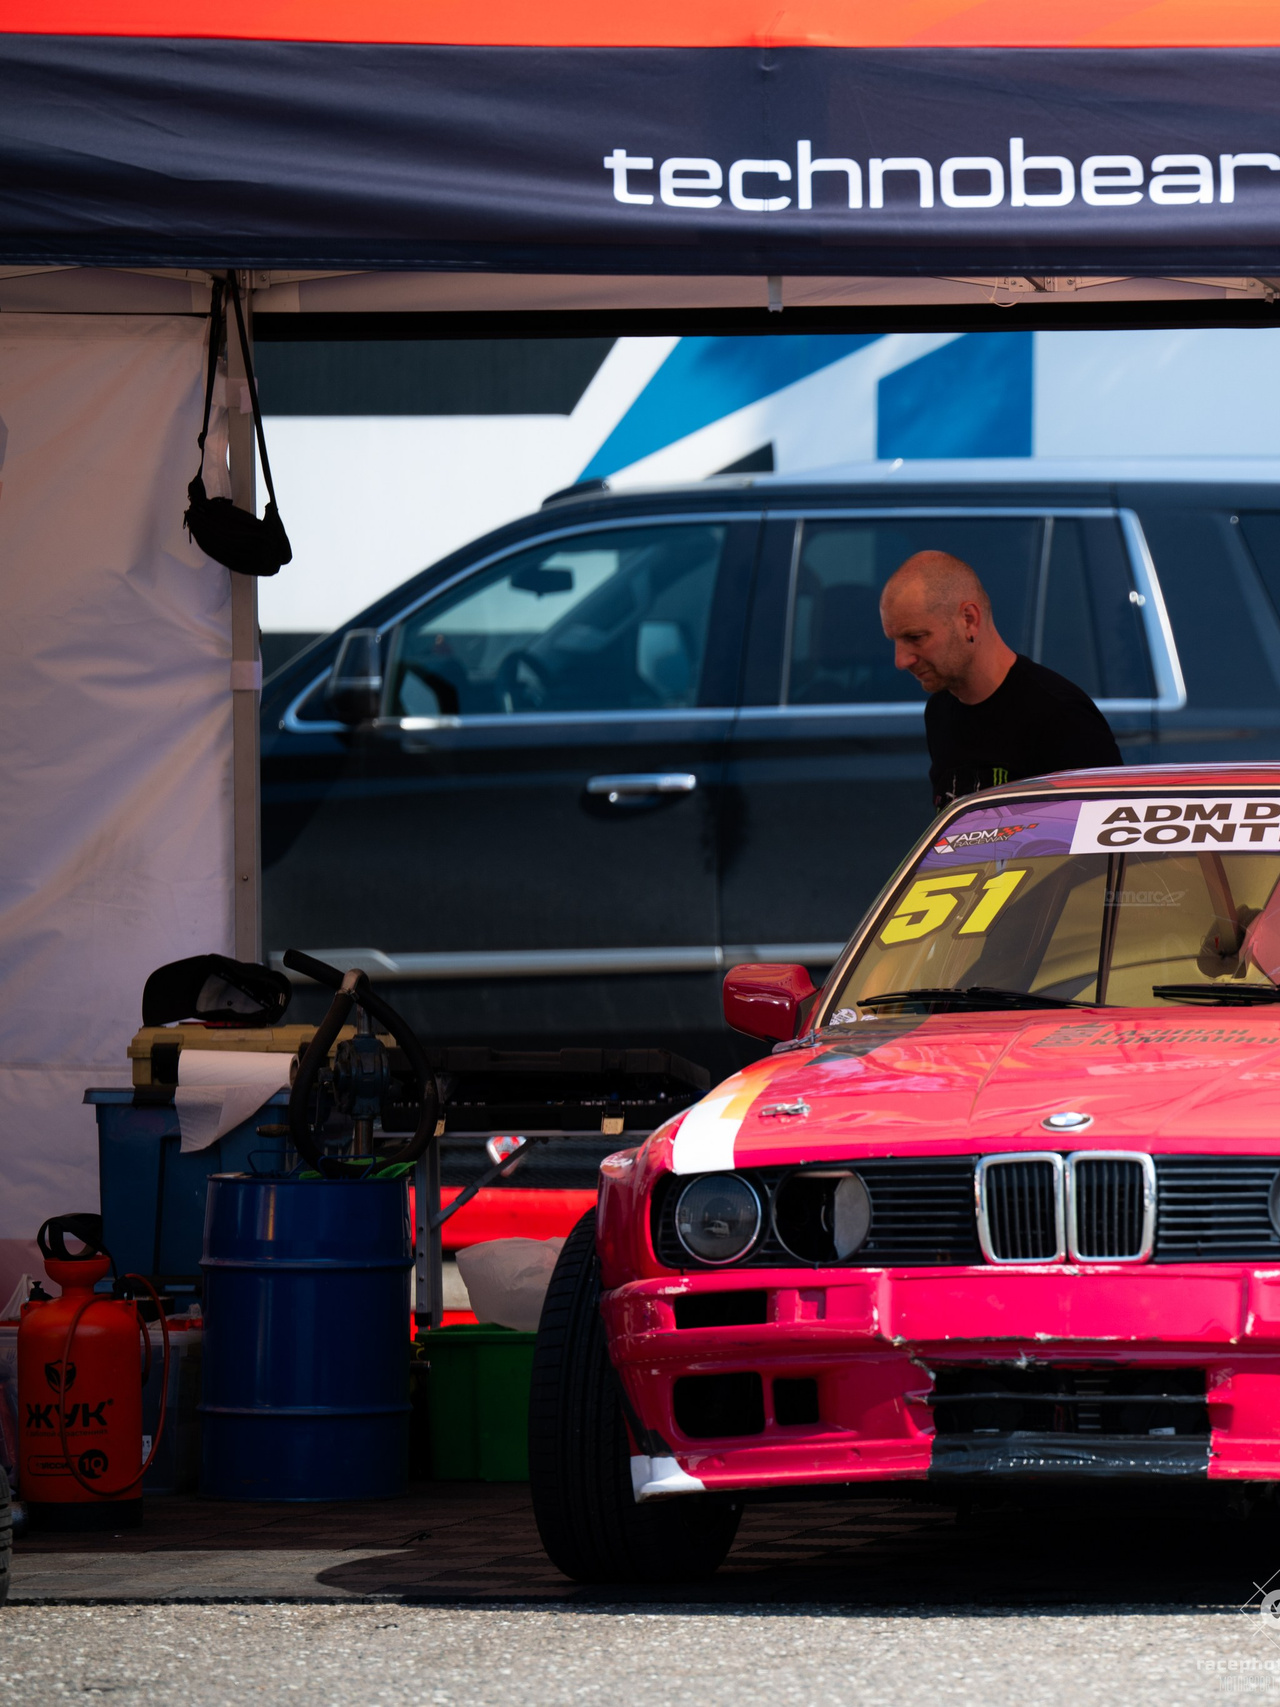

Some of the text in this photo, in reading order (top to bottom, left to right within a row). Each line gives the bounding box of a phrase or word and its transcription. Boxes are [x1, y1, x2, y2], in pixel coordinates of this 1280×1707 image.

[1101, 803, 1233, 825] ADM
[953, 833, 1012, 849] RACEWAY
[956, 828, 999, 842] ADM
[880, 869, 1027, 945] 51
[26, 1401, 108, 1429] ЖУК
